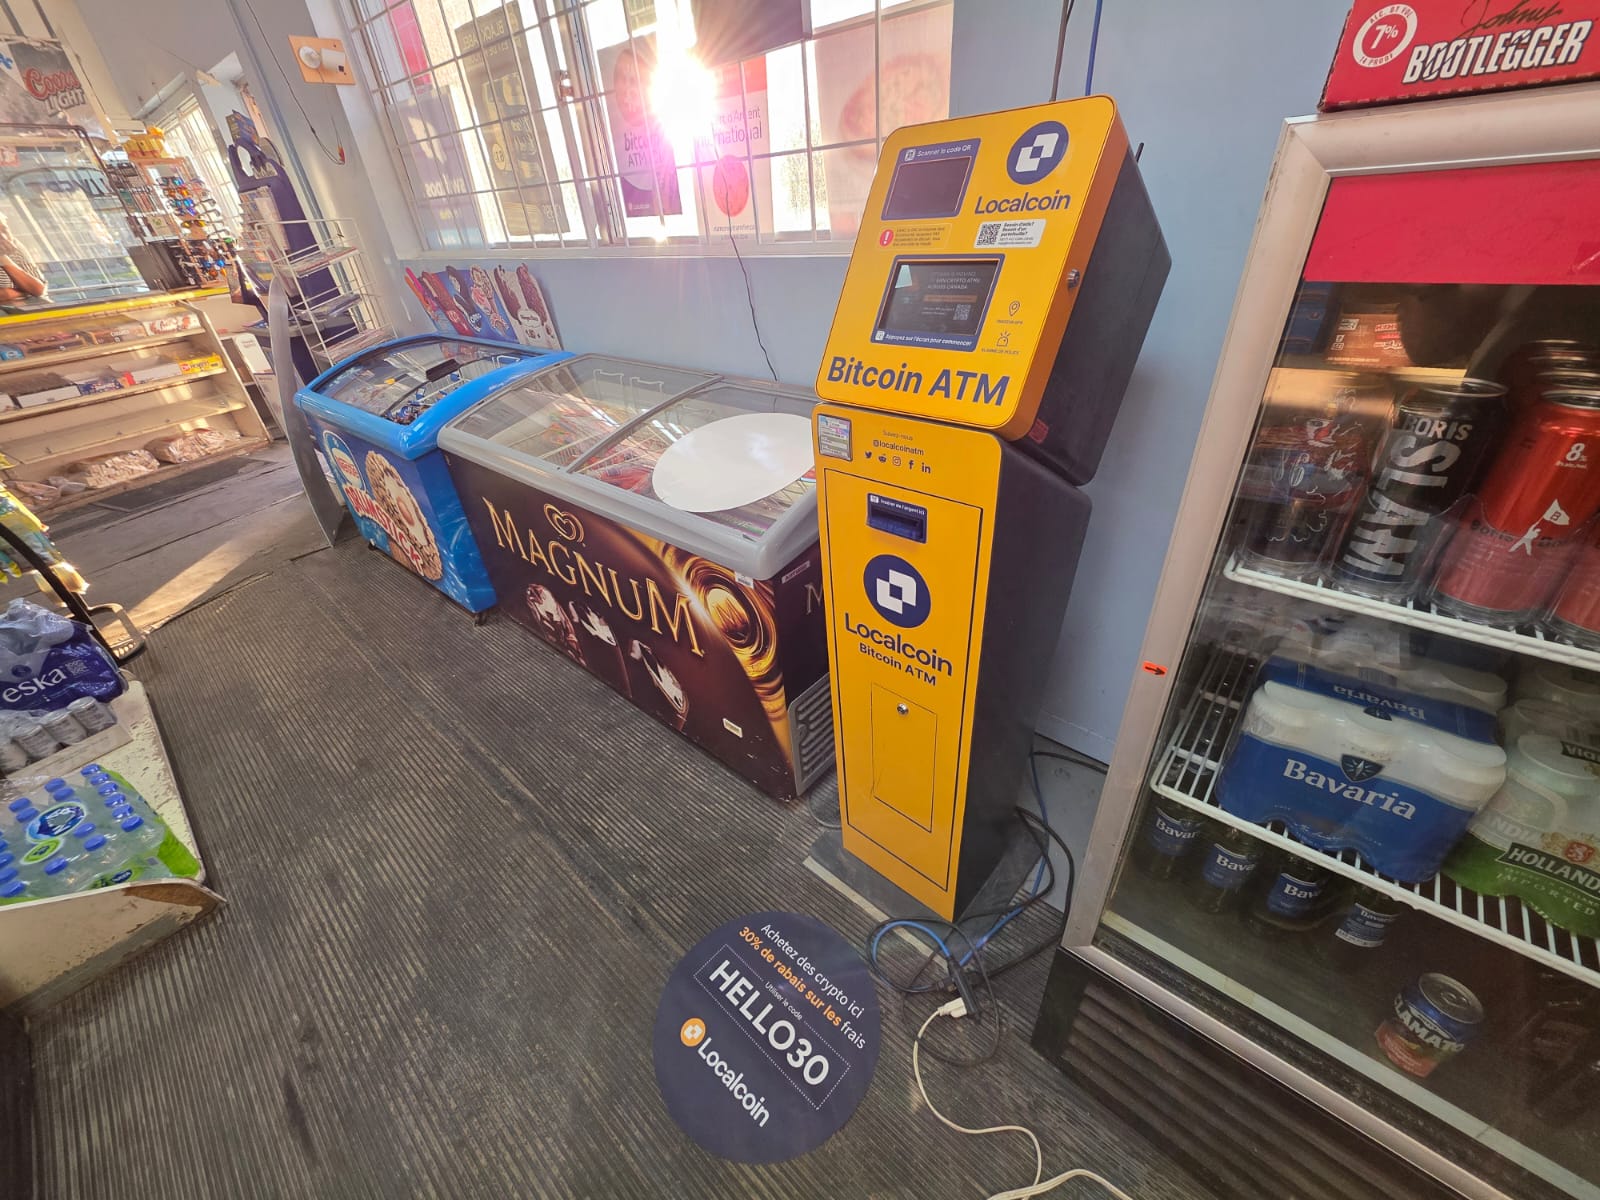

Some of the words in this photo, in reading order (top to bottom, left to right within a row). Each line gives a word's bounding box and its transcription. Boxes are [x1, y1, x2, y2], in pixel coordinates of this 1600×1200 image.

[1370, 24, 1399, 50] 7%
[1402, 20, 1594, 84] BOOTLEGGER
[23, 67, 80, 100] Coors
[45, 88, 86, 117] LIGHT
[974, 189, 1072, 215] Localcoin
[827, 356, 923, 394] Bitcoin
[928, 369, 1010, 406] ATM
[872, 439, 924, 457] @localcoinatm
[1404, 417, 1473, 442] BORIS
[1342, 434, 1462, 577] SLAM
[482, 497, 705, 657] MAGNUM
[845, 612, 953, 677] Localcoin
[859, 642, 902, 671] Bitcoin
[905, 663, 937, 686] ATM
[2, 668, 67, 703] eska
[1332, 684, 1427, 721] Bavaria
[1283, 758, 1417, 821] Bavaria
[1509, 848, 1600, 893] HOLLAND
[738, 926, 762, 951] 30%
[760, 946, 775, 964] de
[773, 958, 806, 994] rabais
[804, 987, 826, 1010] sur
[823, 1004, 843, 1027] les
[839, 1021, 867, 1050] frais
[760, 923, 799, 961] Achetez
[796, 955, 816, 976] des
[814, 971, 849, 1006] crypto
[848, 999, 866, 1020] ici
[708, 959, 830, 1086] HELLO30
[764, 981, 785, 1004] Utiliser
[787, 1005, 803, 1021] code
[697, 1037, 771, 1128] Localcoin
